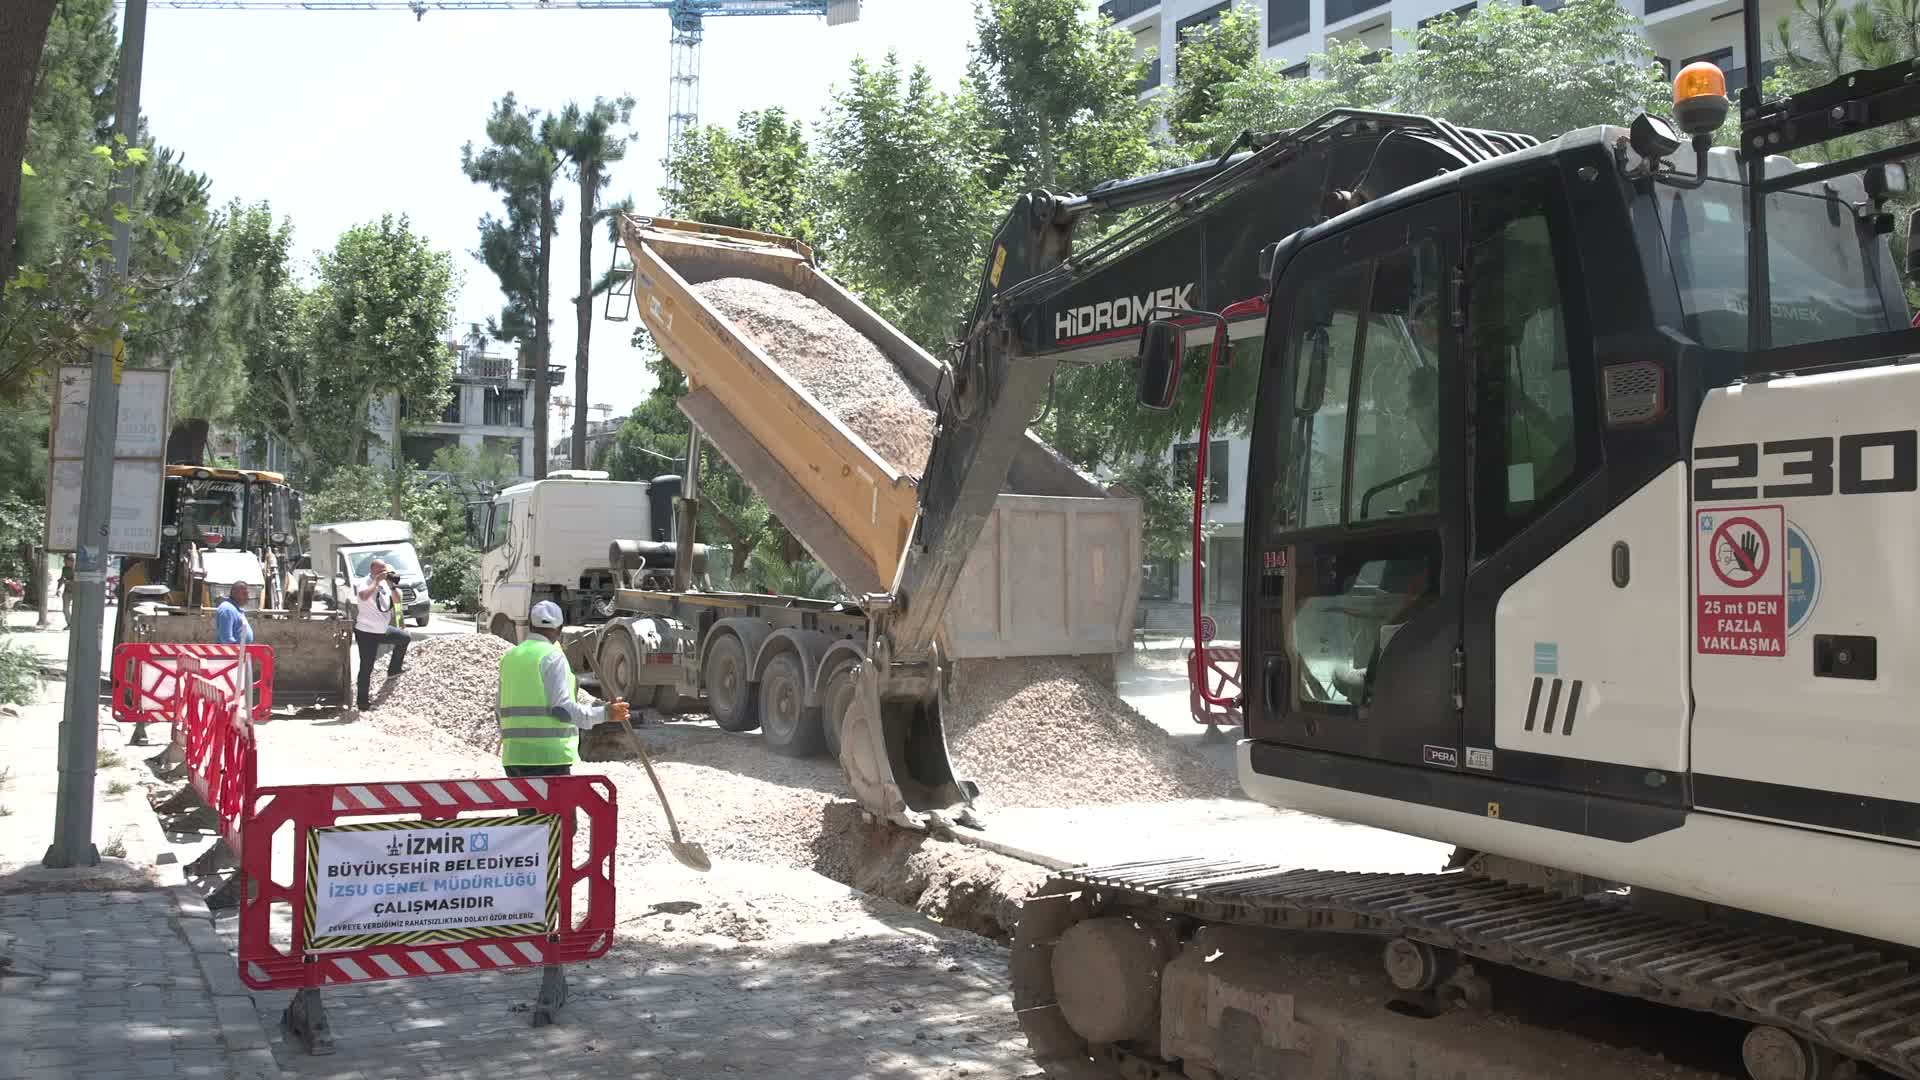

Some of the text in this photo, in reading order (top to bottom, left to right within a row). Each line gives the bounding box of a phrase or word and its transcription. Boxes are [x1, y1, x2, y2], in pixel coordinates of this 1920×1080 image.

[1693, 430, 1918, 502] 230
[1704, 601, 1777, 615] 25 mt DEN
[1718, 619, 1762, 633] FAZLA
[1702, 636, 1781, 654] YAKLAŞMA
[1432, 750, 1456, 763] PERA
[406, 832, 465, 855] İZMİR
[327, 852, 540, 878] BÜYÜKŞEHİR BELEDİYESİ
[329, 872, 537, 898] İZSU GENEL MÜDÜRLÜĞÜ
[374, 896, 494, 915] ÇALIŞMASIDIR
